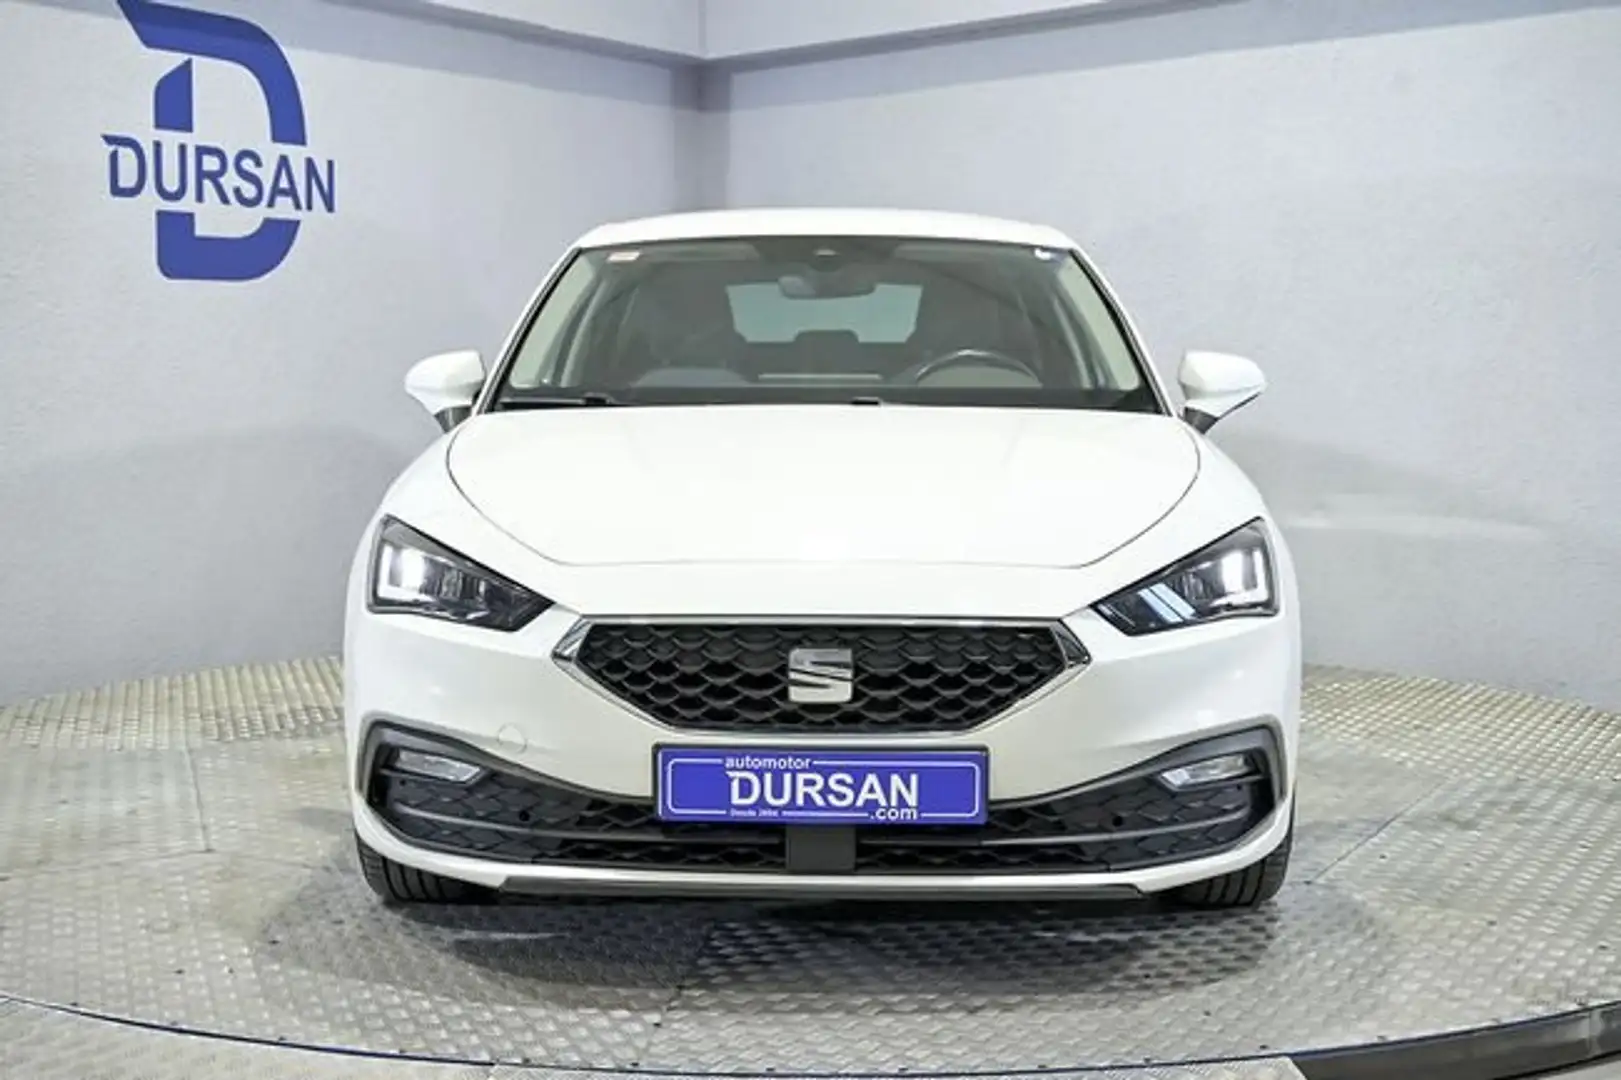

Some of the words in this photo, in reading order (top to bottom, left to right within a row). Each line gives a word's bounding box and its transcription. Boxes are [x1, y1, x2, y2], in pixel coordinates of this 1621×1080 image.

[100, 133, 335, 214] DURSAN
[725, 756, 811, 769] automotor
[726, 771, 919, 807] DURSAN
[870, 807, 918, 821] .com
